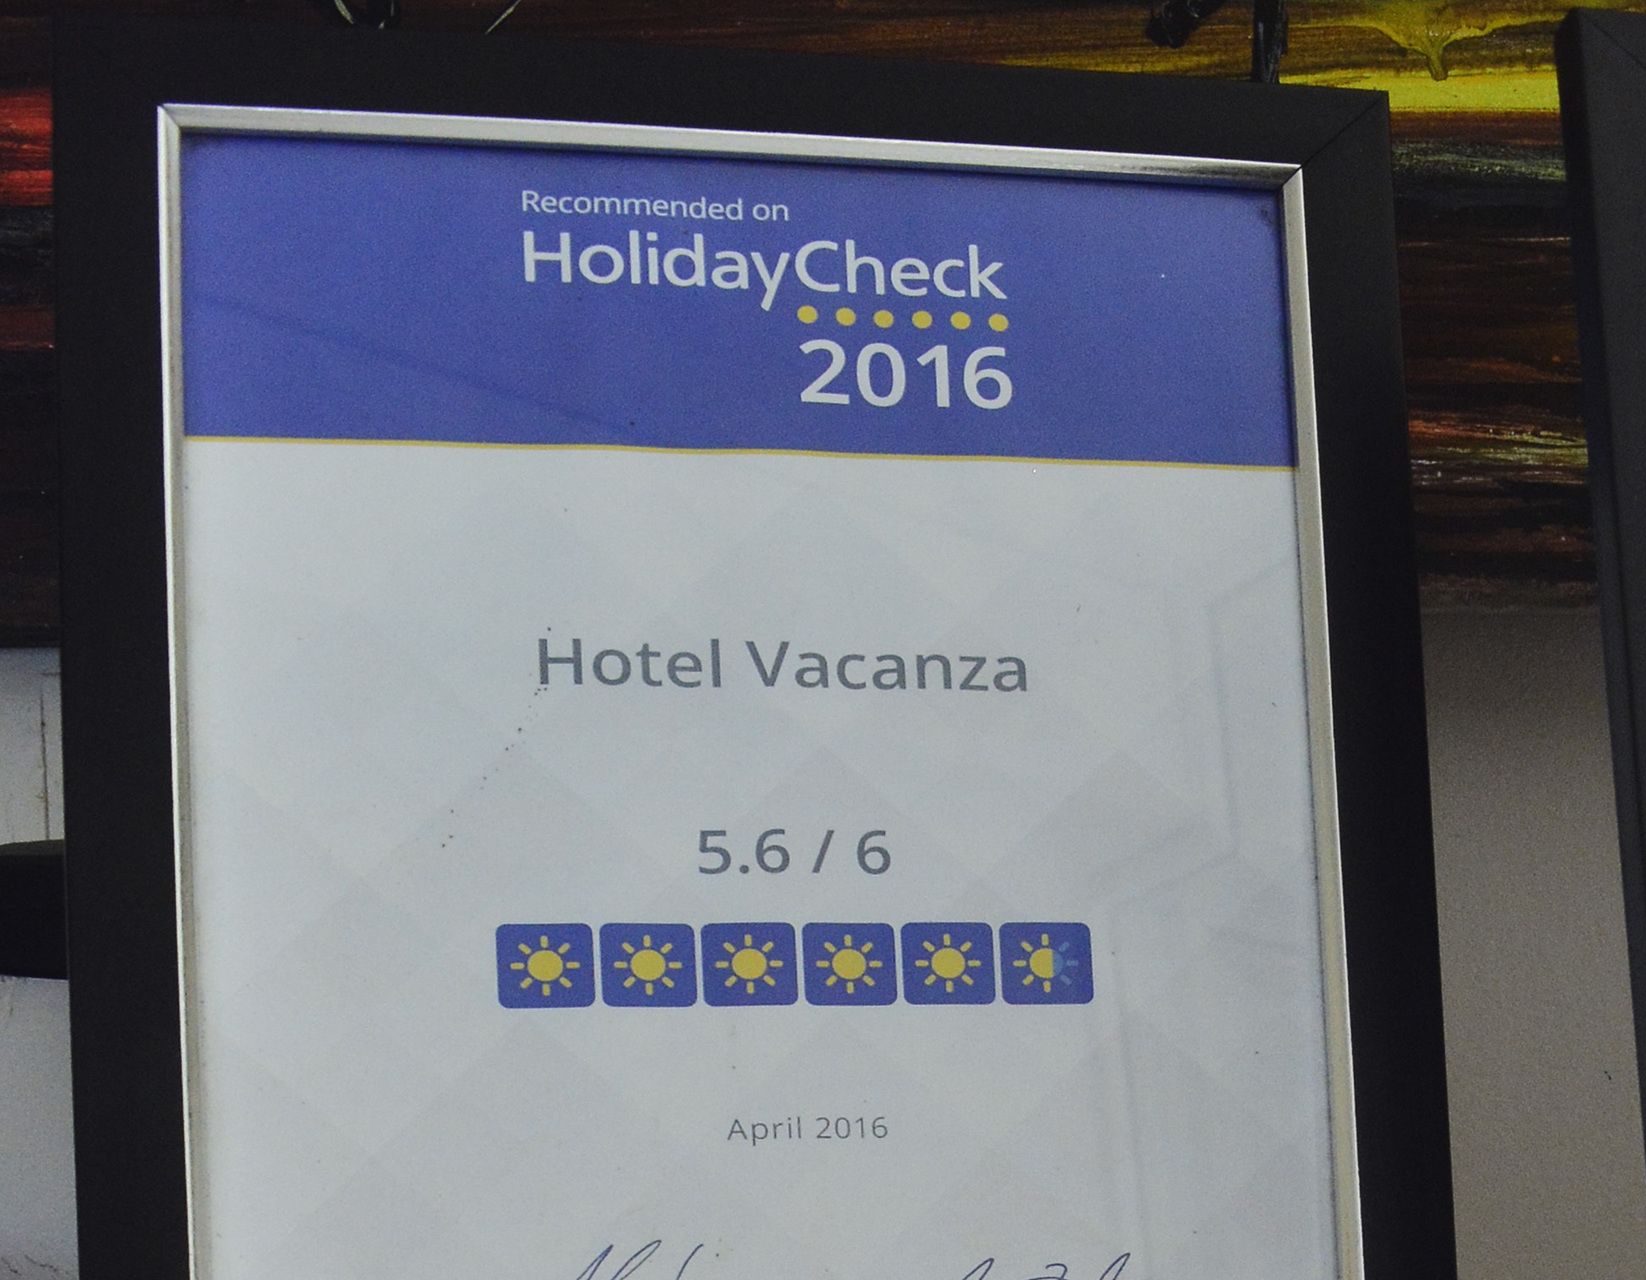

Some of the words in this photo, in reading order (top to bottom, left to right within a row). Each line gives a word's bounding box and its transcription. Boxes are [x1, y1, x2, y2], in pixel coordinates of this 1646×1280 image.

[522, 190, 743, 221] Recommended
[753, 200, 789, 221] on
[523, 231, 1007, 311] HolidayCheck
[799, 339, 1013, 409] 2016
[537, 637, 721, 688] Hotel
[745, 640, 1028, 692] Vacanza
[698, 829, 790, 875] 5.6
[856, 829, 891, 875] 6
[726, 1117, 802, 1146] April
[816, 1116, 888, 1140] 2016
